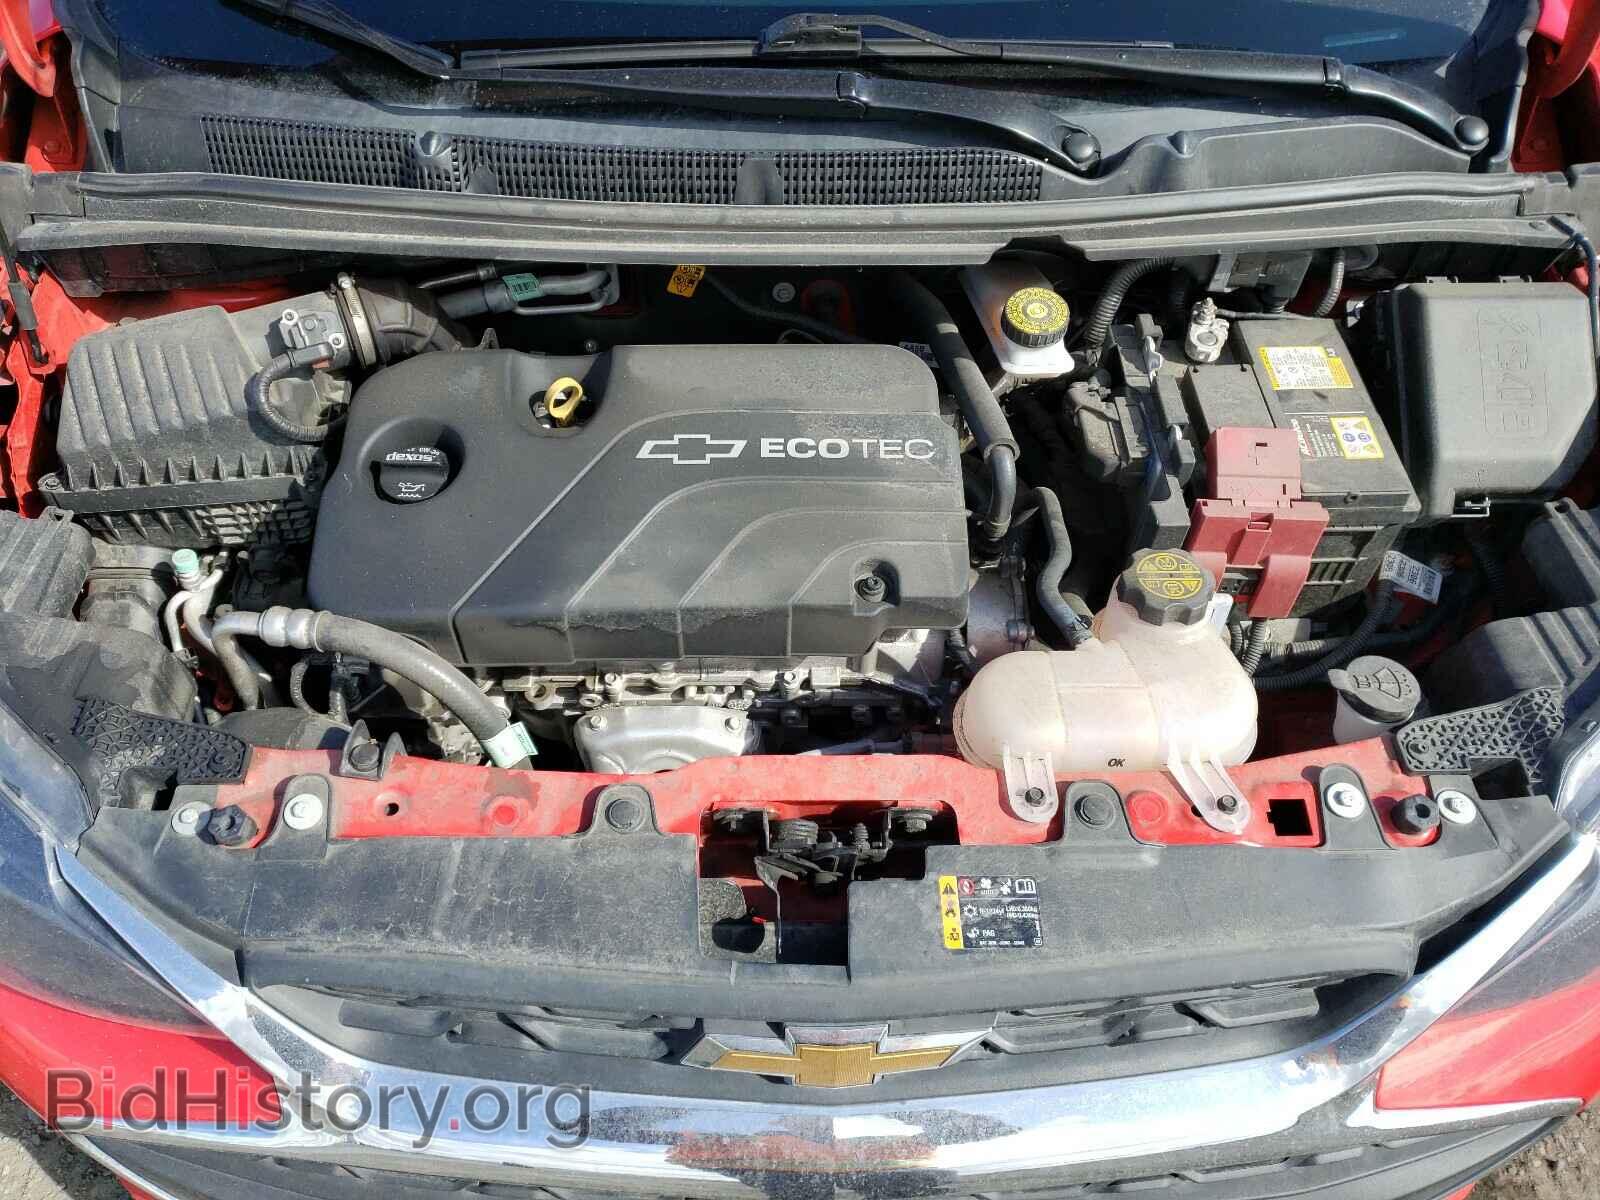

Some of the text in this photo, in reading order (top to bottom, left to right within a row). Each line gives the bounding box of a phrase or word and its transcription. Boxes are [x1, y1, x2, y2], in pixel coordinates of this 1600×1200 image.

[760, 437, 937, 460] ECOTEC
[385, 452, 433, 461] dexos
[1107, 758, 1125, 767] OK
